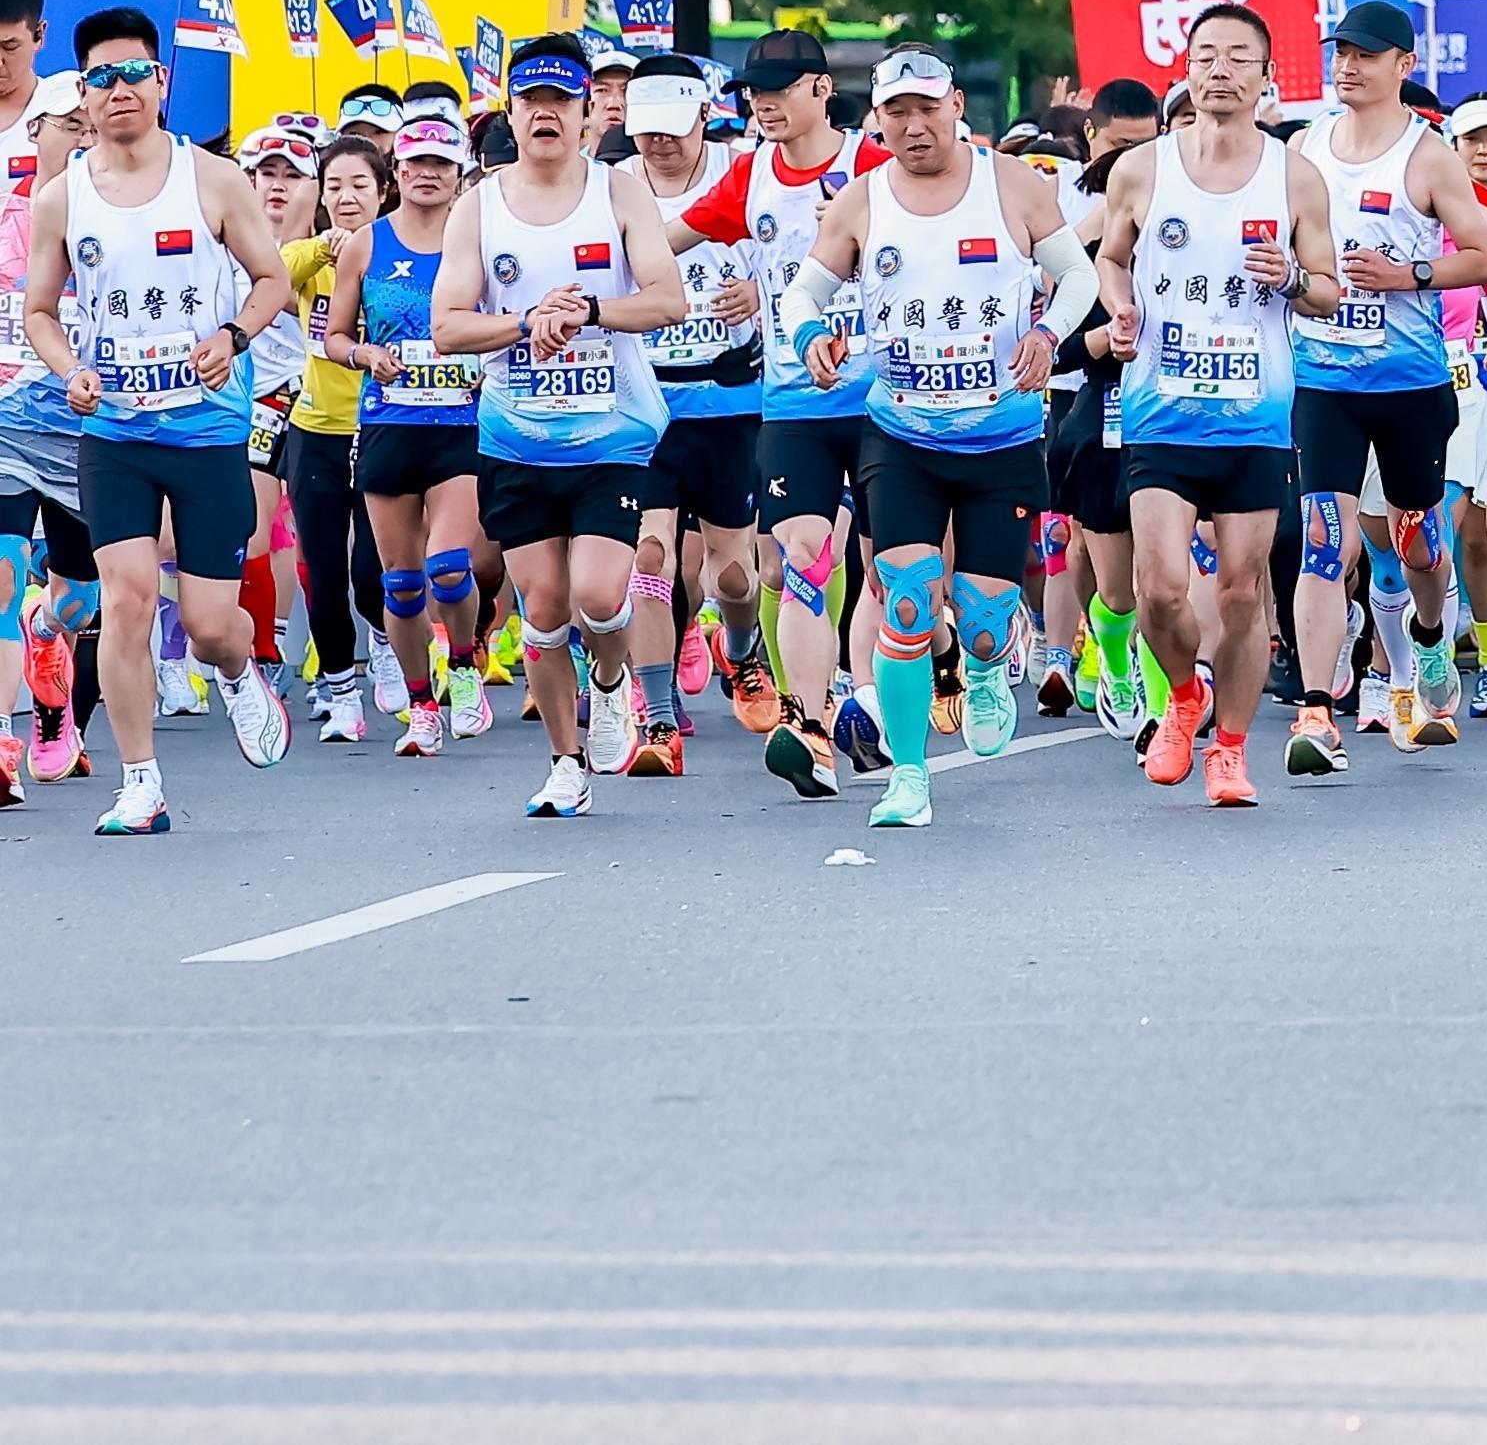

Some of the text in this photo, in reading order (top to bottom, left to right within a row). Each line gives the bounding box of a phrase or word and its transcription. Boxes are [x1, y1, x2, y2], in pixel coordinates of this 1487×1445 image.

[1154, 273, 1275, 308] 中國警察
[877, 295, 1006, 332] 中國警察
[1313, 304, 1382, 329] 159
[656, 320, 727, 347] 28200
[120, 362, 196, 392] 28170
[915, 362, 993, 391] 28193
[1183, 353, 1256, 380] 28156
[535, 367, 612, 397] 28169
